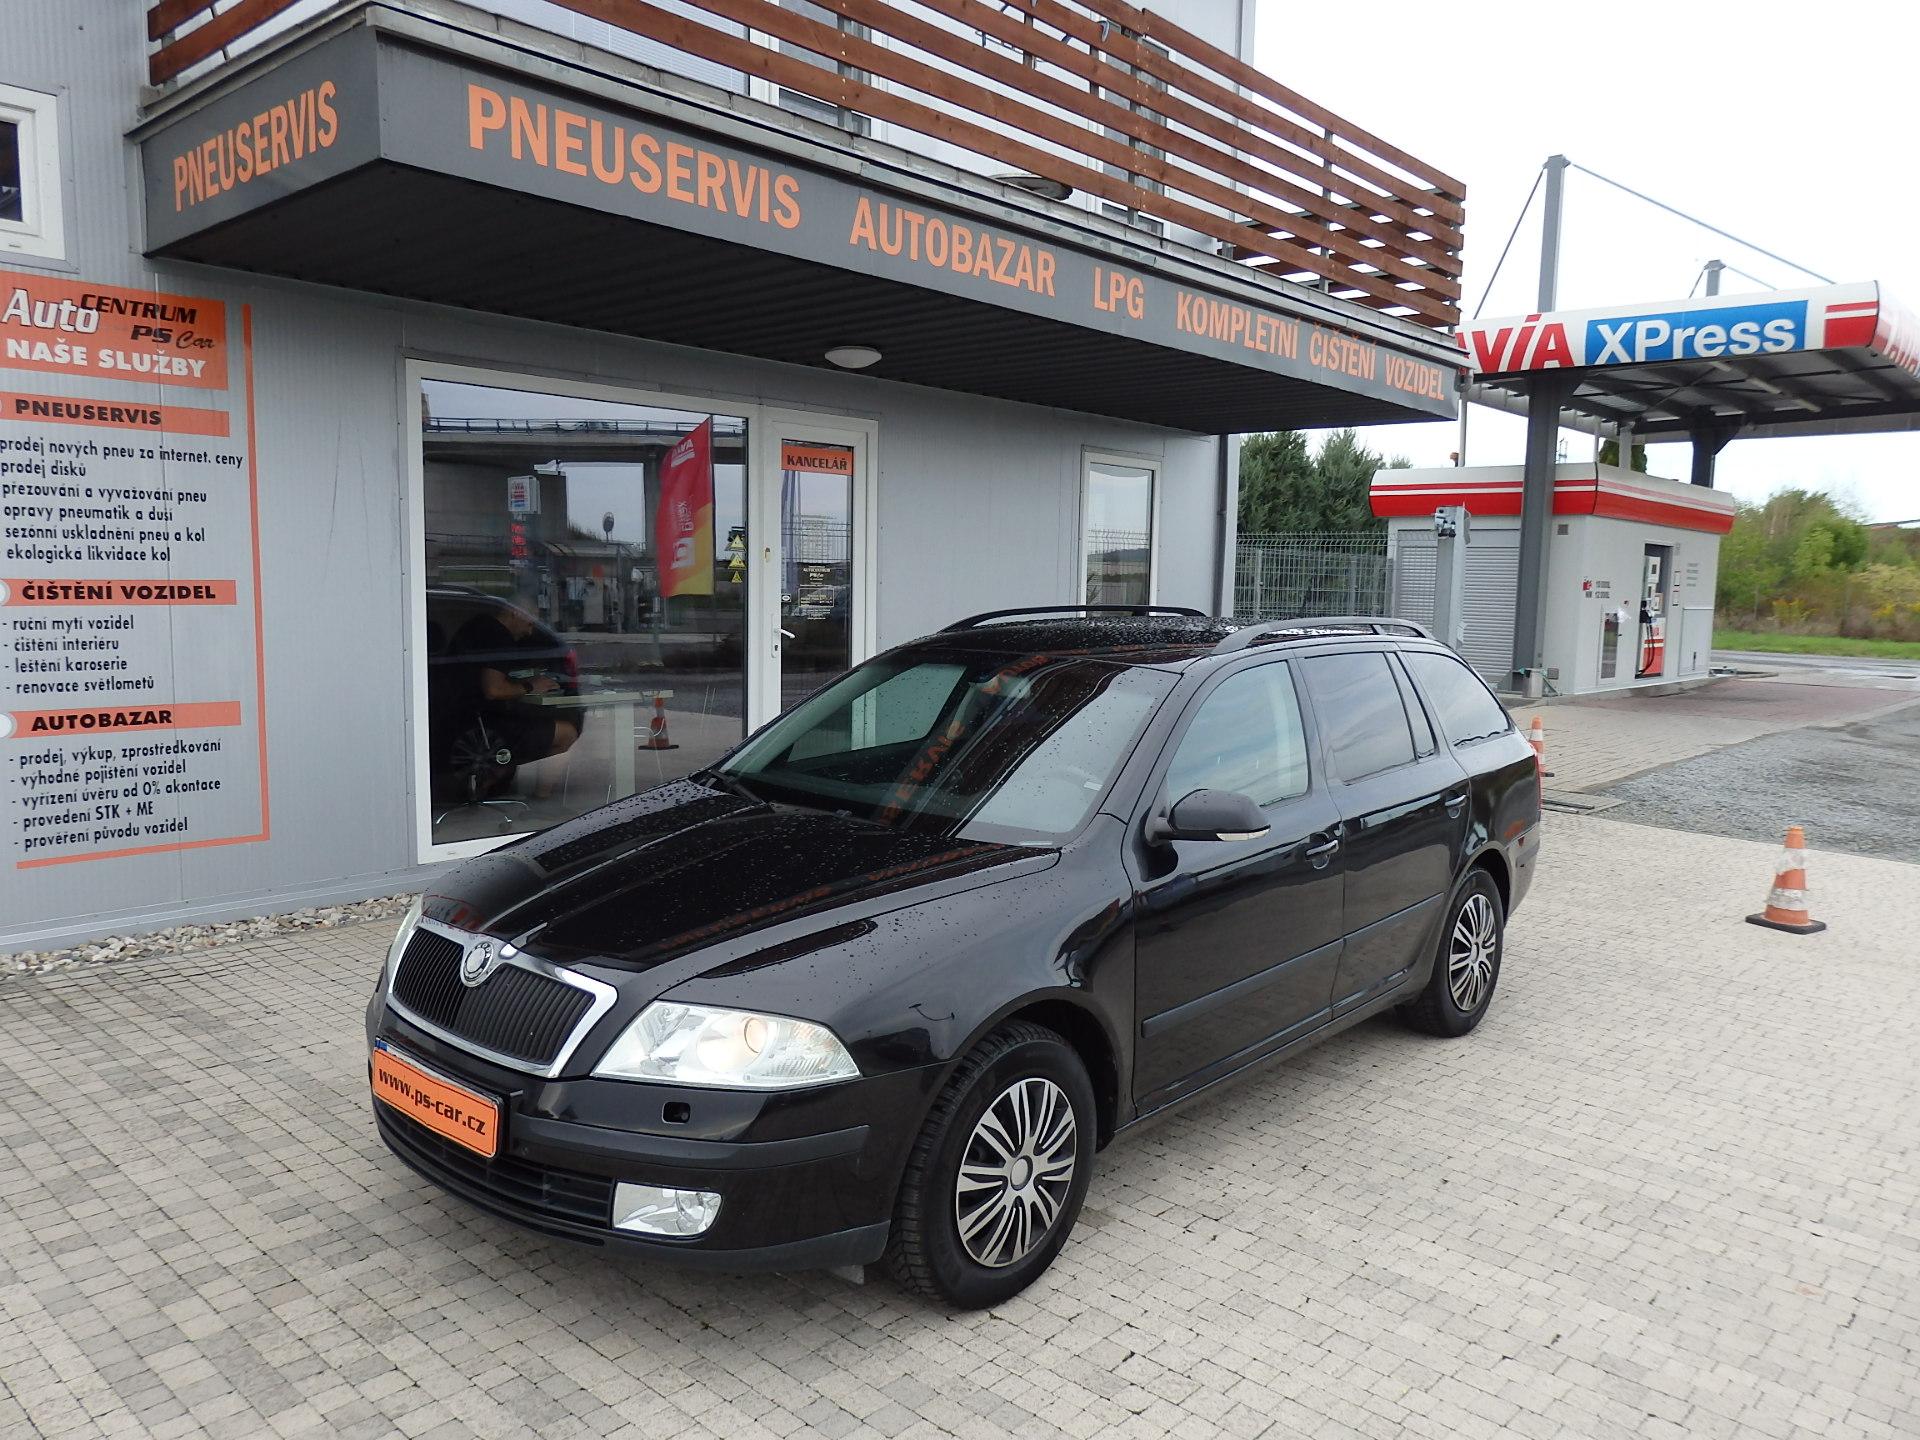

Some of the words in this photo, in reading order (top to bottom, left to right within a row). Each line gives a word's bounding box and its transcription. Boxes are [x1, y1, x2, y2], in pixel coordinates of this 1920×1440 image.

[173, 80, 338, 211] PNEUSERVIS
[468, 84, 800, 230] PNEUSERVIS
[850, 196, 1056, 297] AUTOBAZAR
[1093, 267, 1144, 320] LPG
[1176, 291, 1301, 360] KOMPLETNÍ
[1308, 322, 1377, 381] ČIŠTĚNÍ
[1385, 353, 1444, 400] VOZIDEL
[0, 287, 100, 334] Auto
[80, 294, 197, 324] CENTRUM
[131, 325, 173, 343] PS
[176, 331, 215, 349] Car
[1595, 318, 1797, 364] XPress
[6, 337, 88, 366] NAŠE
[98, 350, 207, 378] SLUŽBY
[15, 399, 162, 425] PNEUSERVIS
[0, 436, 45, 457] prodej
[49, 440, 98, 458] nových
[103, 446, 134, 460] pneu
[139, 448, 154, 459] za
[160, 446, 212, 463] internet.
[215, 454, 244, 469] ceny
[787, 455, 848, 470] KANCELÁŘ
[1, 458, 46, 479] prodej
[2, 481, 80, 499] přezouvání
[85, 488, 93, 497] a
[99, 486, 173, 502] vyvažování
[178, 491, 207, 505] pneu
[4, 506, 54, 521] opravy
[59, 505, 130, 521] pneumatik
[136, 510, 143, 520] a
[5, 524, 58, 539] sezónní
[62, 524, 135, 540] uskladnění
[139, 531, 170, 544] pneu
[174, 531, 182, 541] a
[186, 526, 205, 541] kol
[7, 543, 82, 564] ekologická
[88, 545, 147, 560] likvidace
[151, 546, 171, 561] kol
[22, 581, 112, 600] ČIŠTĚNÍ
[120, 585, 216, 599] VOZIDEL
[13, 617, 47, 631] ruční
[88, 615, 134, 630] vozidel
[14, 636, 58, 651] čištění
[62, 635, 119, 651] interiéru
[15, 657, 61, 673] leštění
[65, 656, 128, 671] karoserie
[16, 680, 79, 694] renovace
[84, 675, 154, 692] světlometů
[31, 710, 172, 731] AUTOBAZAR
[20, 748, 67, 769] prodej,
[72, 746, 116, 766] výkup,
[121, 738, 222, 759] zprostředkování
[21, 770, 79, 790] výhodné
[85, 765, 138, 784] pojištění
[143, 759, 186, 776] vozidel
[22, 790, 77, 810] vyřízení
[82, 786, 118, 802] úvěru
[123, 782, 138, 798] od
[143, 780, 161, 796] 0%
[165, 779, 221, 794] akontace
[23, 810, 91, 831] provedení
[95, 804, 120, 820] STK
[136, 801, 154, 816] ME
[24, 830, 89, 852] prověření
[94, 825, 139, 844] původu
[144, 816, 188, 834] vozidel
[378, 1067, 486, 1136] www.ps-car.cz
